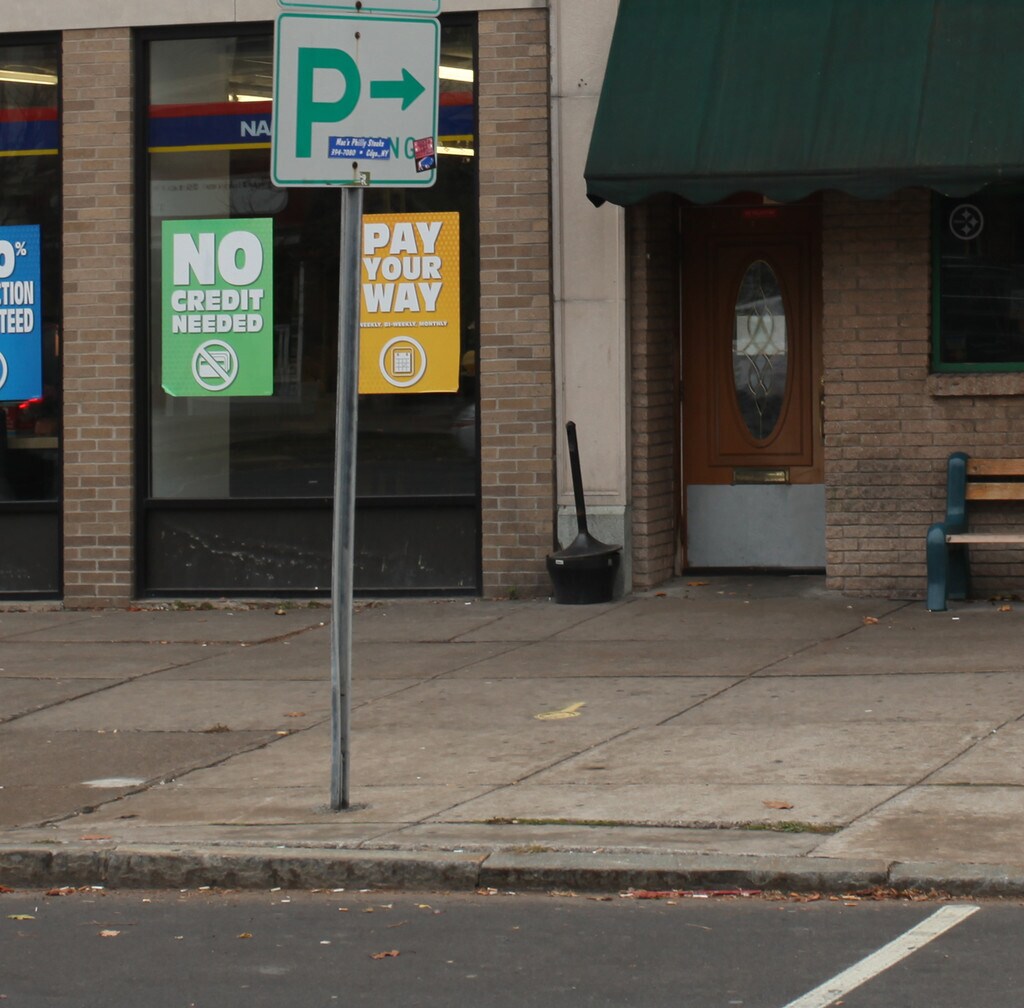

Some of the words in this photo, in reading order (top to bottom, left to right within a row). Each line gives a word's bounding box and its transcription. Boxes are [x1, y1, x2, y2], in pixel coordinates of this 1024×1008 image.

[295, 46, 362, 159] P
[240, 120, 272, 138] NA
[363, 221, 444, 255] PAY
[173, 230, 264, 286] NO
[362, 256, 442, 281] YOUR
[0, 280, 34, 306] TION
[171, 289, 265, 312] CREDIT
[362, 281, 443, 313] WAY
[172, 313, 264, 334] NEEDED
